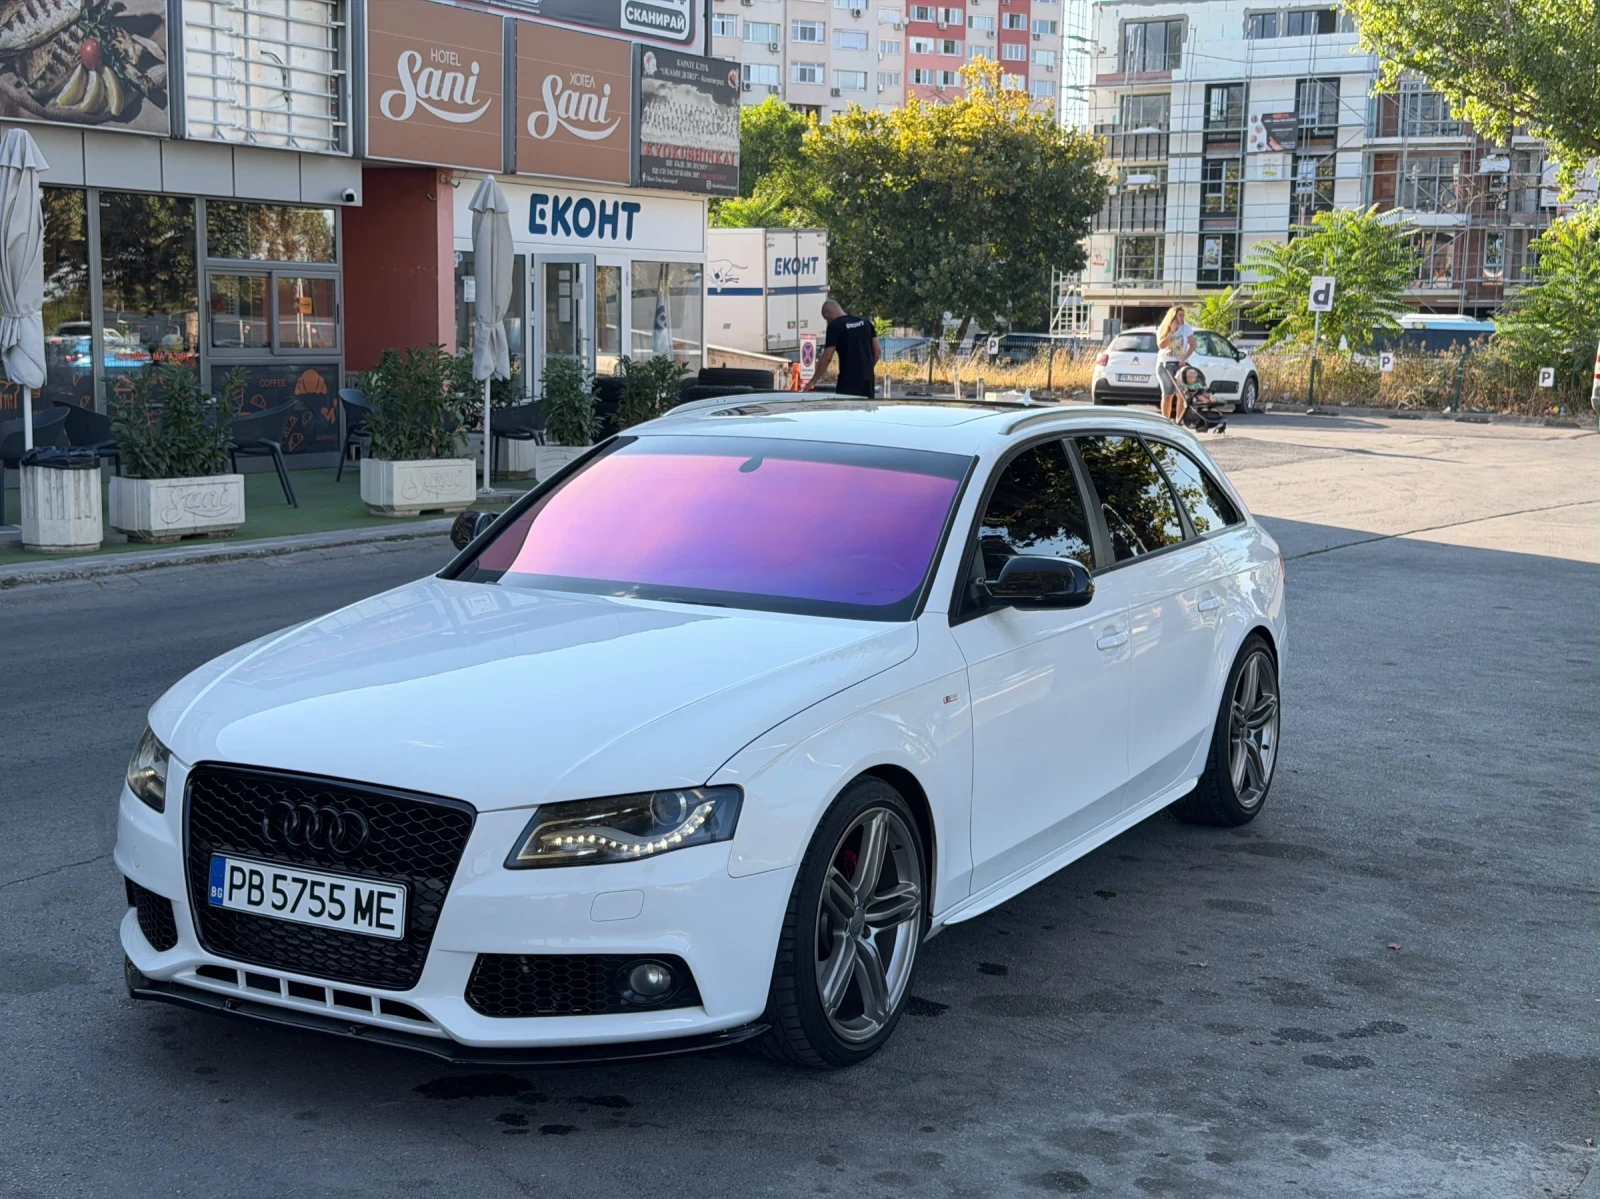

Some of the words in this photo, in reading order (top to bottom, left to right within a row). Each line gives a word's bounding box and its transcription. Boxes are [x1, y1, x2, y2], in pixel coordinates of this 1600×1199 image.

[626, 6, 685, 31] СКАНИРАЙ
[430, 48, 462, 67] HOTEL
[676, 59, 695, 70] КАРАТЕ
[380, 50, 486, 122] Sani
[569, 72, 596, 89] ХОТЕЛ
[527, 74, 616, 140] Sani
[645, 142, 736, 166] KYOKUSHINKAI
[529, 193, 641, 241] ЕКОНТ
[774, 256, 819, 276] ЕКОНТ
[1382, 357, 1391, 369] P
[259, 379, 287, 387] COFFEE
[1542, 372, 1551, 384] P
[211, 886, 223, 899] BG
[228, 865, 265, 907] PB
[271, 873, 346, 921] 5755
[353, 887, 397, 931] ME
